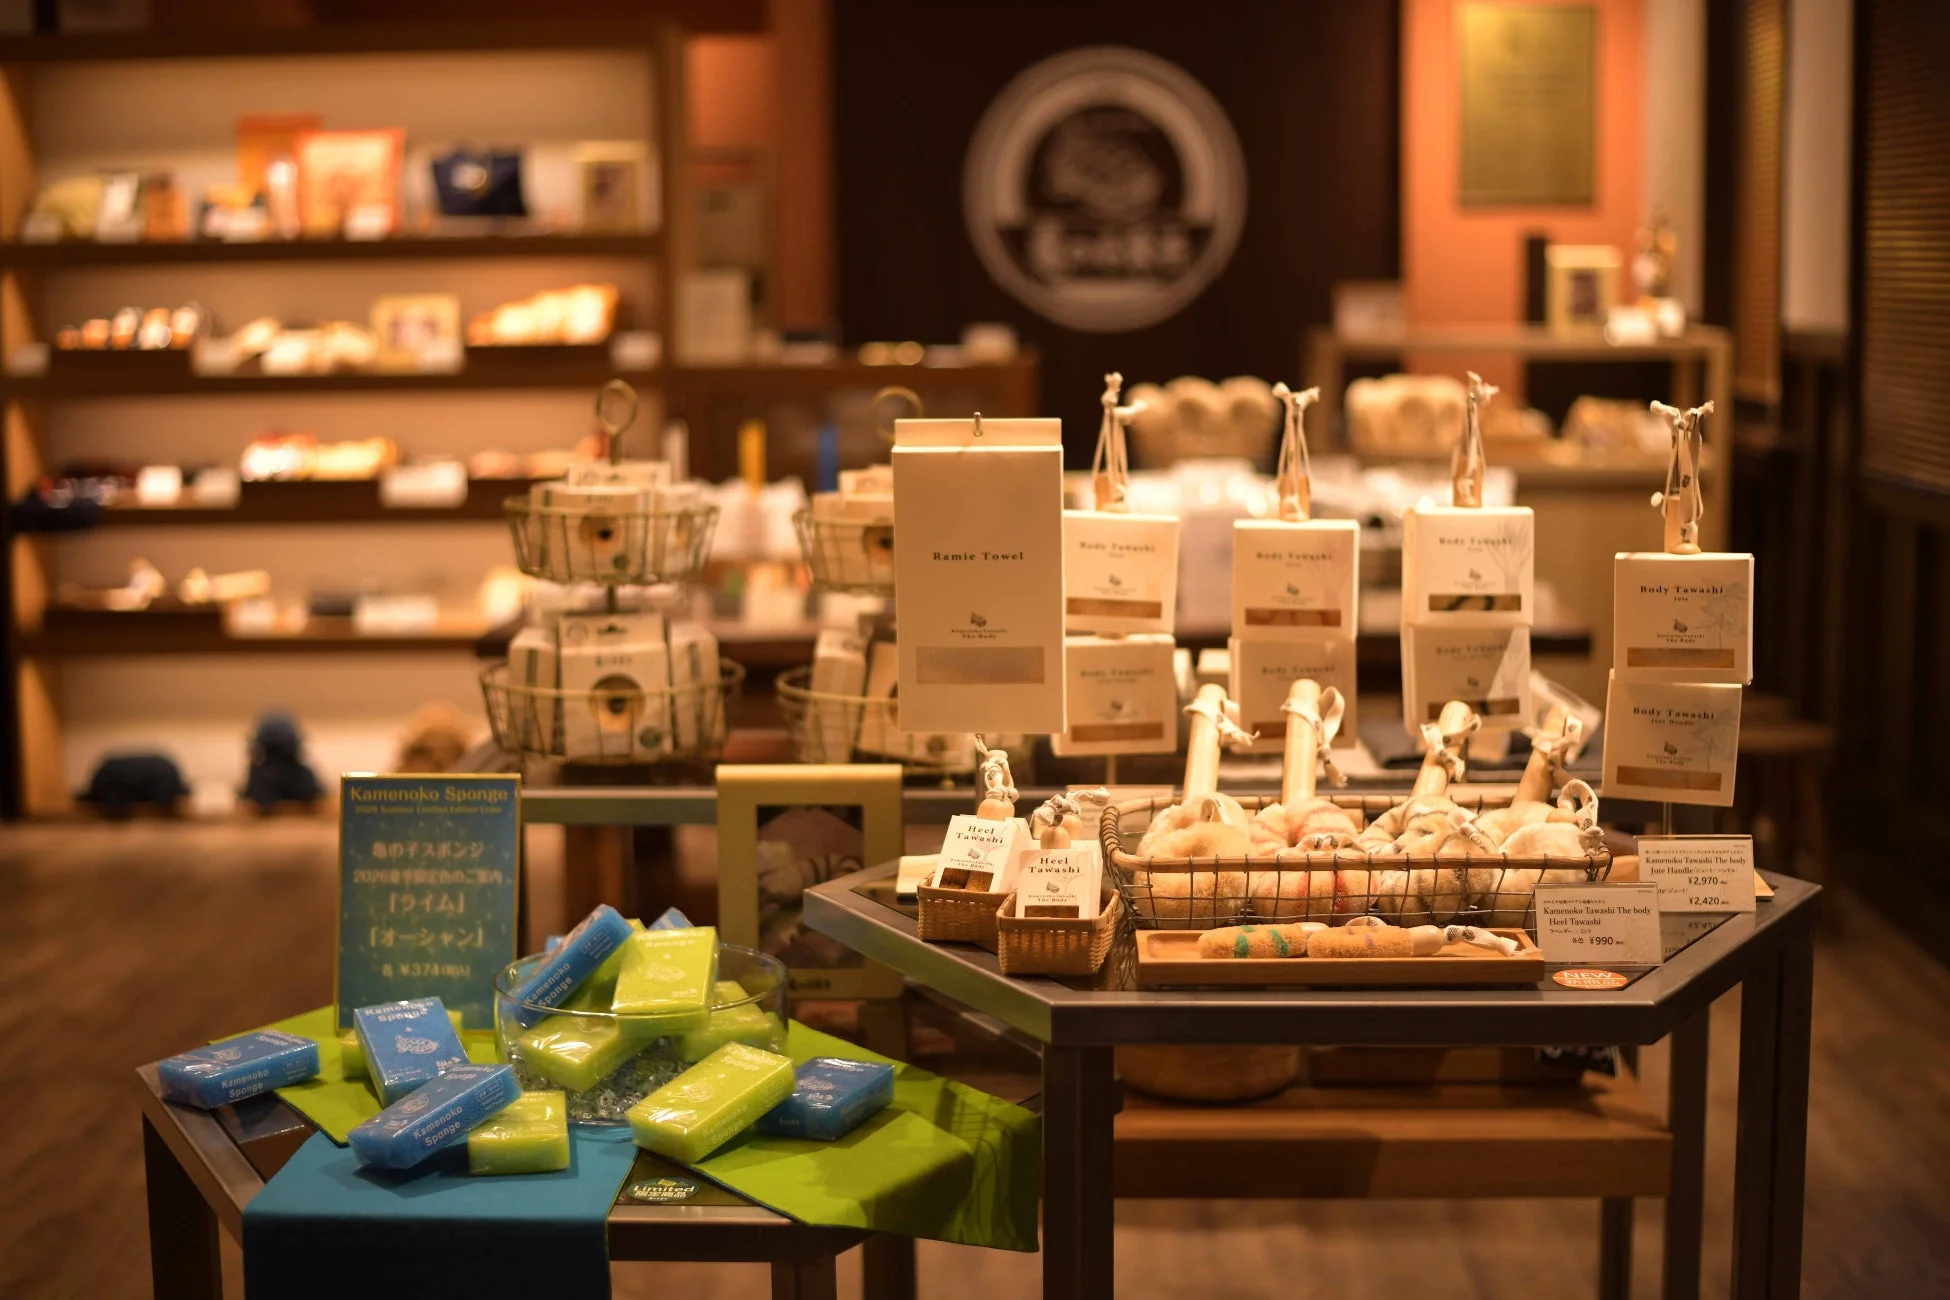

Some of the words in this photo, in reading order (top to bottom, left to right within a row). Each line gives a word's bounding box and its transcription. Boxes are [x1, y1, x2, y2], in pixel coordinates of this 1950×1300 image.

[933, 551, 976, 561] Ramie
[983, 551, 1024, 561] Towel
[1640, 586, 1669, 595] Body
[1675, 586, 1724, 594] Tawashi
[1633, 707, 1660, 717] Body
[1666, 709, 1714, 719] Tawashi
[351, 786, 440, 801] Kamenoko
[445, 786, 508, 803] Sponge
[968, 825, 994, 835] Heel
[956, 832, 1004, 844] Tawashi
[1730, 857, 1746, 865] body
[1650, 867, 1666, 875] Jute
[1688, 877, 1719, 886] ¥2,970
[389, 891, 465, 914] 「ライム」
[1689, 897, 1720, 906] ¥2,420
[1634, 907, 1652, 915] body
[370, 926, 484, 947] 「オーシャン」
[1589, 937, 1614, 945] ¥990
[222, 1069, 269, 1089] Kamenoko
[229, 1082, 264, 1098] Sponge
[413, 1106, 463, 1139] Kamenoko
[425, 1121, 461, 1147] Sponge
